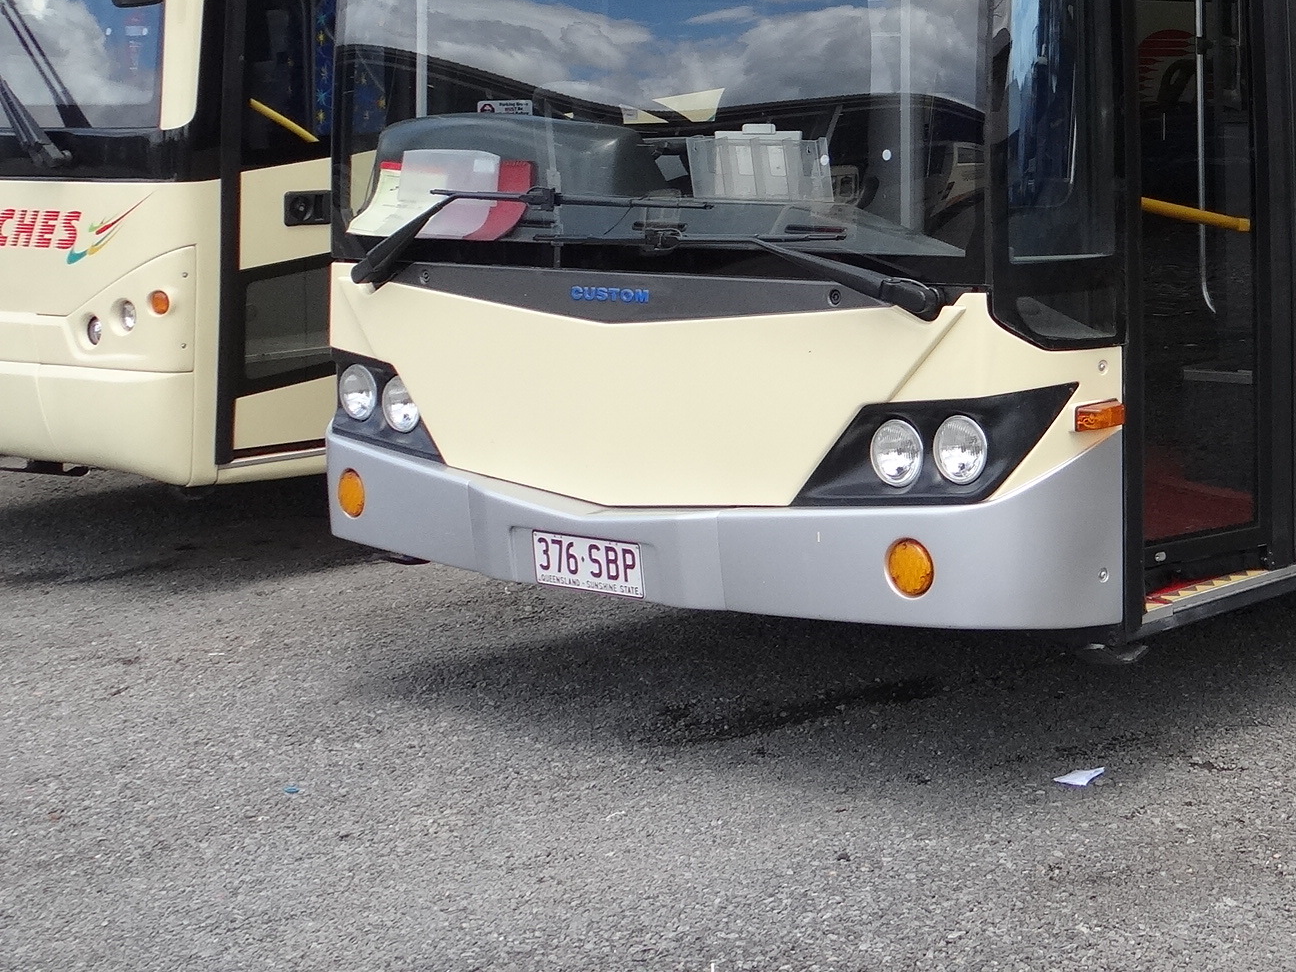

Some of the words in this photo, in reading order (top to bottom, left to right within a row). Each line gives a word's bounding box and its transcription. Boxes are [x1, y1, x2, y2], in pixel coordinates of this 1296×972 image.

[0, 209, 81, 249] CHES
[570, 285, 650, 303] CUSTOM
[541, 574, 580, 587] QUEENSLAND
[586, 580, 617, 592] SUNSHINE
[620, 585, 639, 595] STATE
